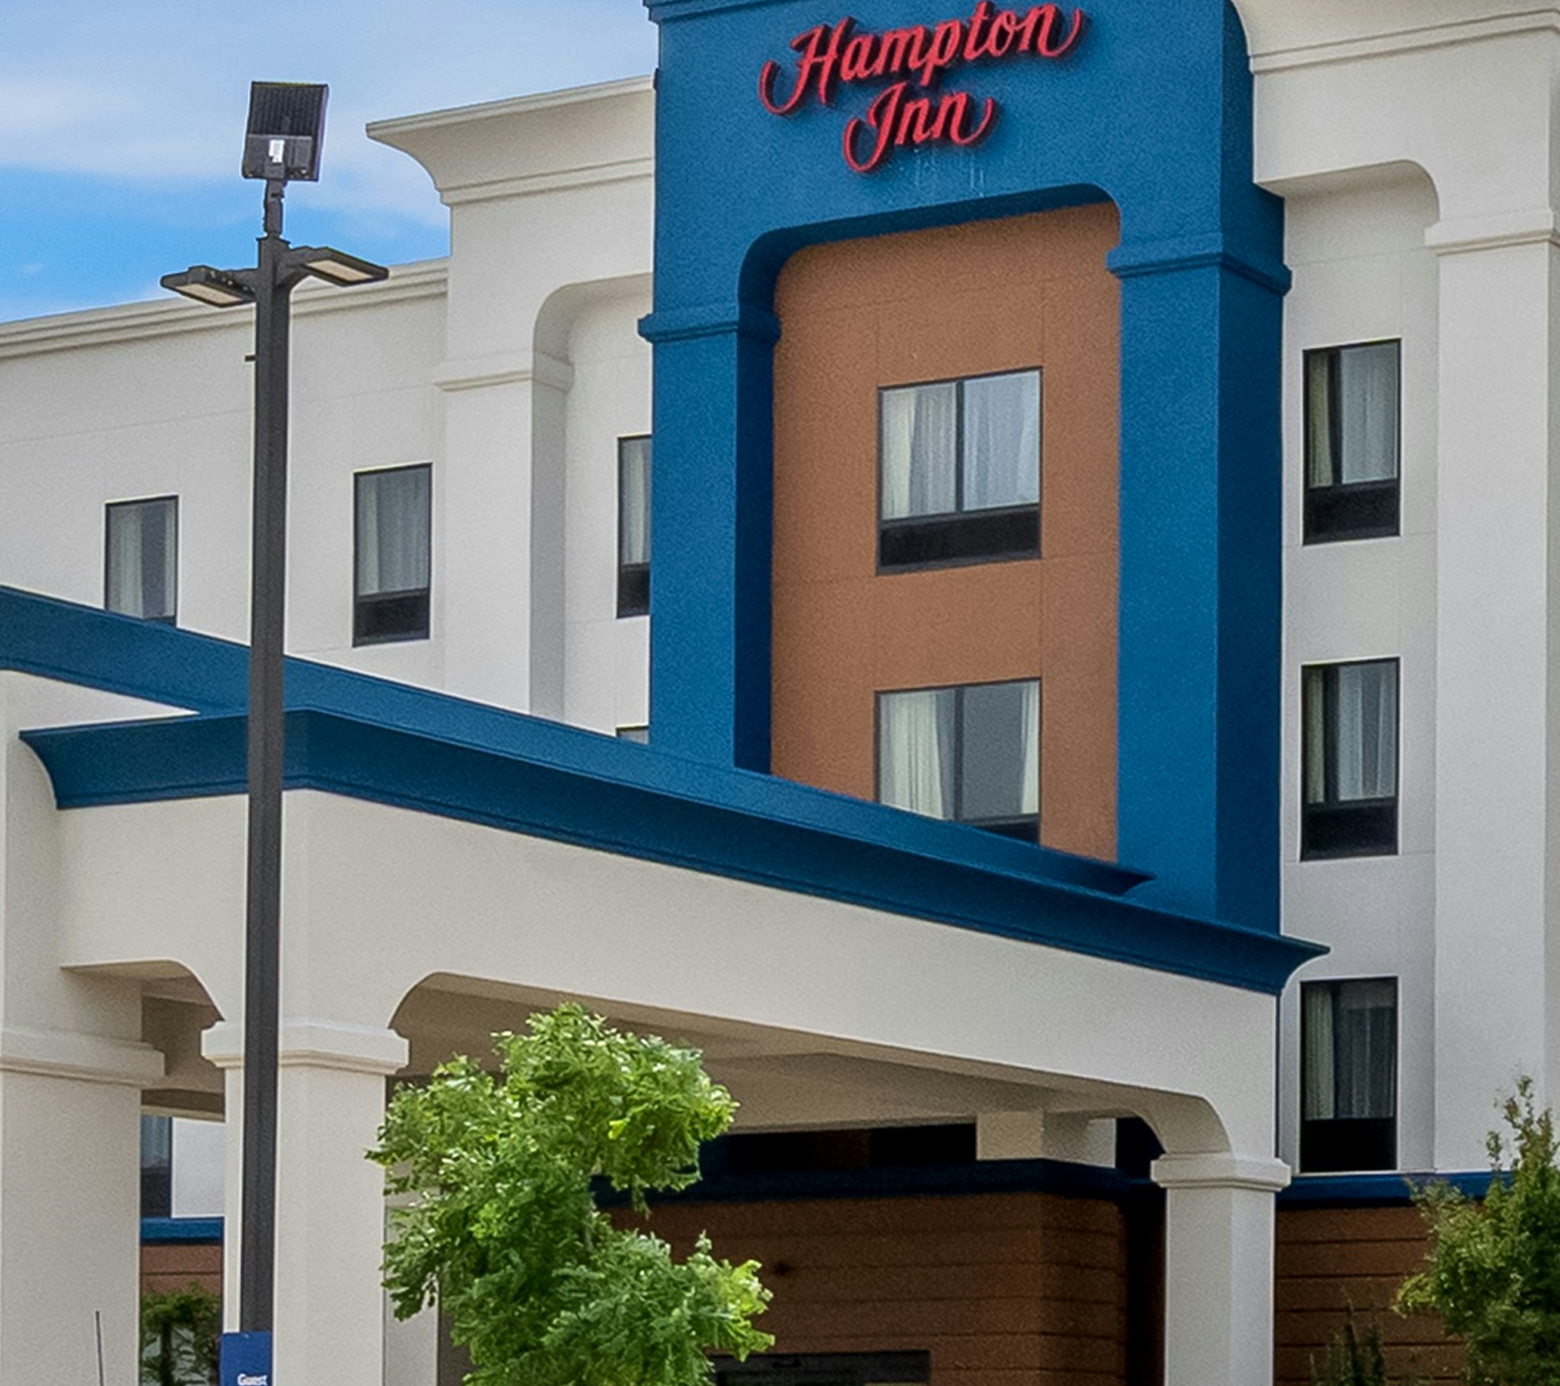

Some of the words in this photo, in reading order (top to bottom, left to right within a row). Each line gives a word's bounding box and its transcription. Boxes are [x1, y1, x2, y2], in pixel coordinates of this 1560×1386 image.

[760, 0, 1085, 116] Hampton
[842, 81, 995, 173] Inn
[237, 1373, 268, 1386] Guest
